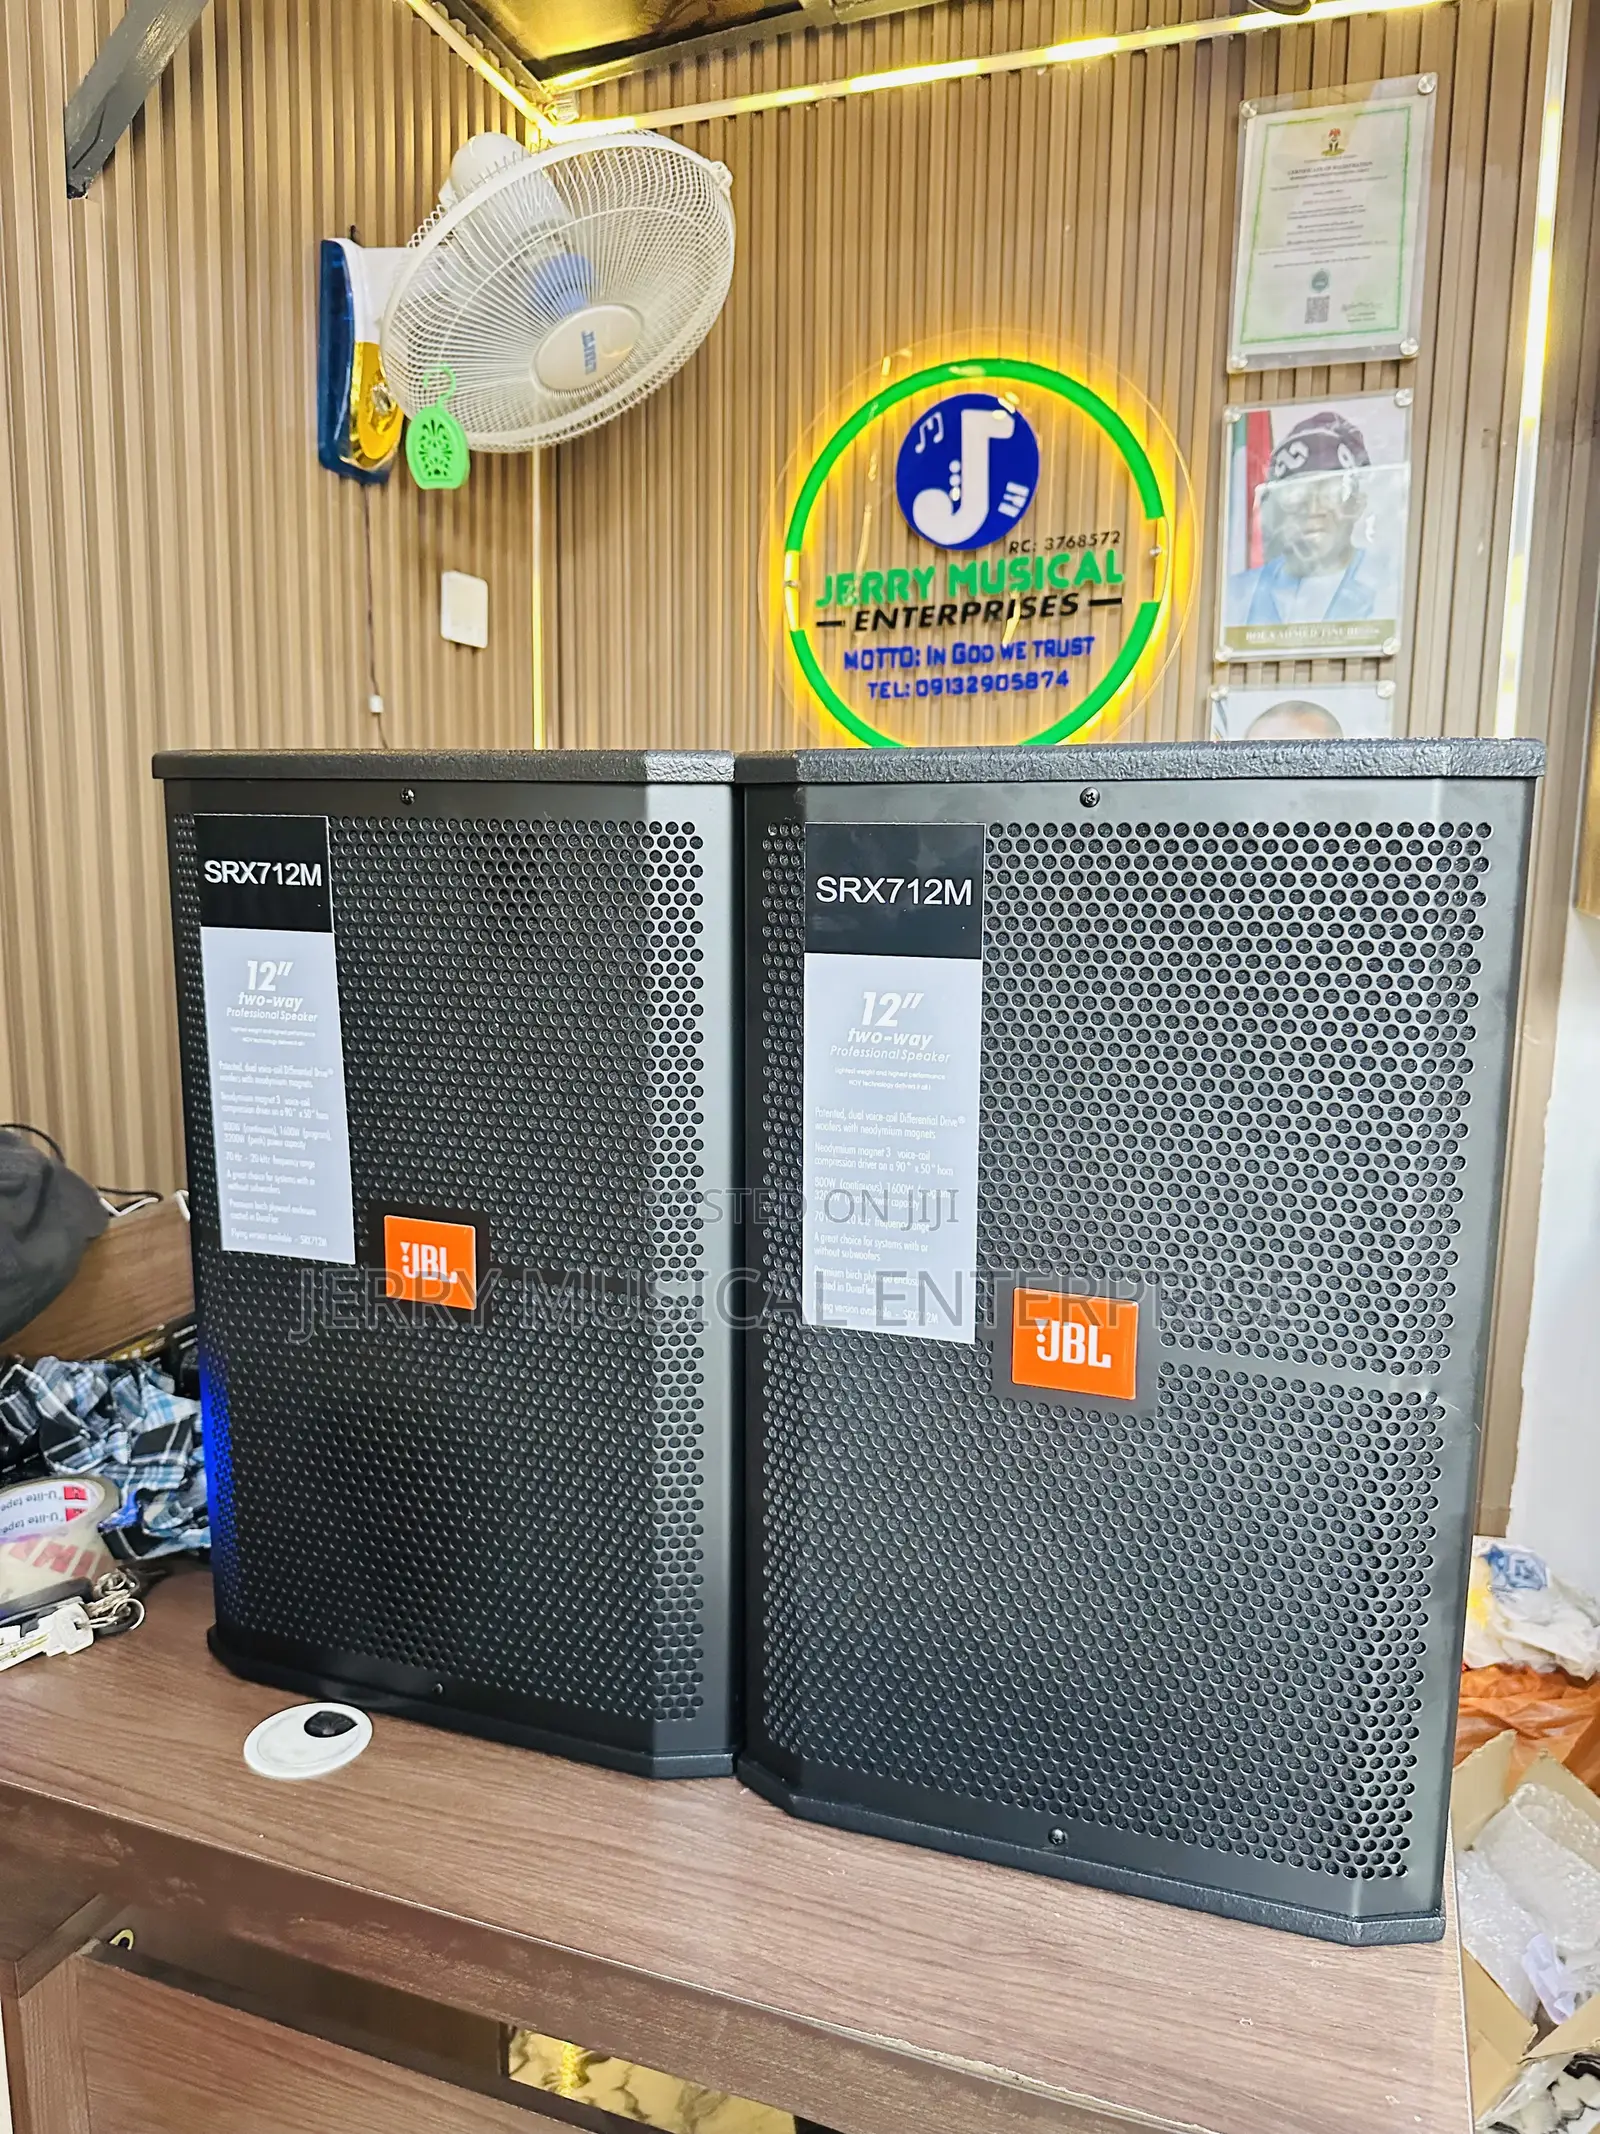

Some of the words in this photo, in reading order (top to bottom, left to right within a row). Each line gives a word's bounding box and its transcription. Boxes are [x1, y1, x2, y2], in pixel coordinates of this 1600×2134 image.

[1009, 541, 1037, 555] RC:
[1044, 530, 1121, 552] 3768572
[815, 566, 936, 609] JERRY
[948, 549, 1124, 597] MUSICAL
[854, 592, 1080, 632] ENTERPRISES
[843, 645, 920, 671] MOTTO:
[952, 642, 995, 666] GOD
[1000, 641, 1028, 661] WE
[1032, 636, 1096, 660] TRUST
[867, 681, 910, 700] TEL:
[916, 669, 1070, 698] 09132905874
[204, 860, 322, 887] SRX712M
[815, 876, 972, 906] SRX712M
[238, 992, 304, 1012] two-way
[226, 1007, 279, 1020] Professional
[280, 1010, 318, 1022] Speaker
[848, 1028, 934, 1050] two-way
[830, 1045, 900, 1061] Professional
[901, 1049, 951, 1063] Speaker
[815, 1107, 847, 1122] Patented,
[849, 1109, 864, 1121] dual
[866, 1111, 899, 1123] voice-coil
[900, 1112, 939, 1126] Differential
[815, 1120, 841, 1132] woofers
[843, 1122, 859, 1133] with
[860, 1124, 904, 1138] neodymium
[905, 1128, 937, 1141] magnets
[814, 1142, 856, 1157] Neodymium
[896, 1148, 930, 1161] voice-coil
[815, 1156, 857, 1172] compression
[858, 1159, 877, 1170] driver
[891, 1199, 920, 1212] capacty
[909, 1220, 930, 1233] ange
[814, 1231, 820, 1242] A
[821, 1233, 840, 1247] great
[840, 1234, 861, 1246] choice
[862, 1235, 873, 1247] for
[874, 1239, 903, 1251] systems
[814, 1245, 841, 1257] without
[401, 1242, 458, 1283] JBL
[814, 1264, 843, 1279] Pmium
[863, 1269, 892, 1284] plywod
[814, 1280, 836, 1293] ated
[834, 1302, 858, 1315] version
[860, 1305, 893, 1319] availle
[902, 1309, 940, 1325] SRX2M
[1035, 1319, 1111, 1369] JBL
